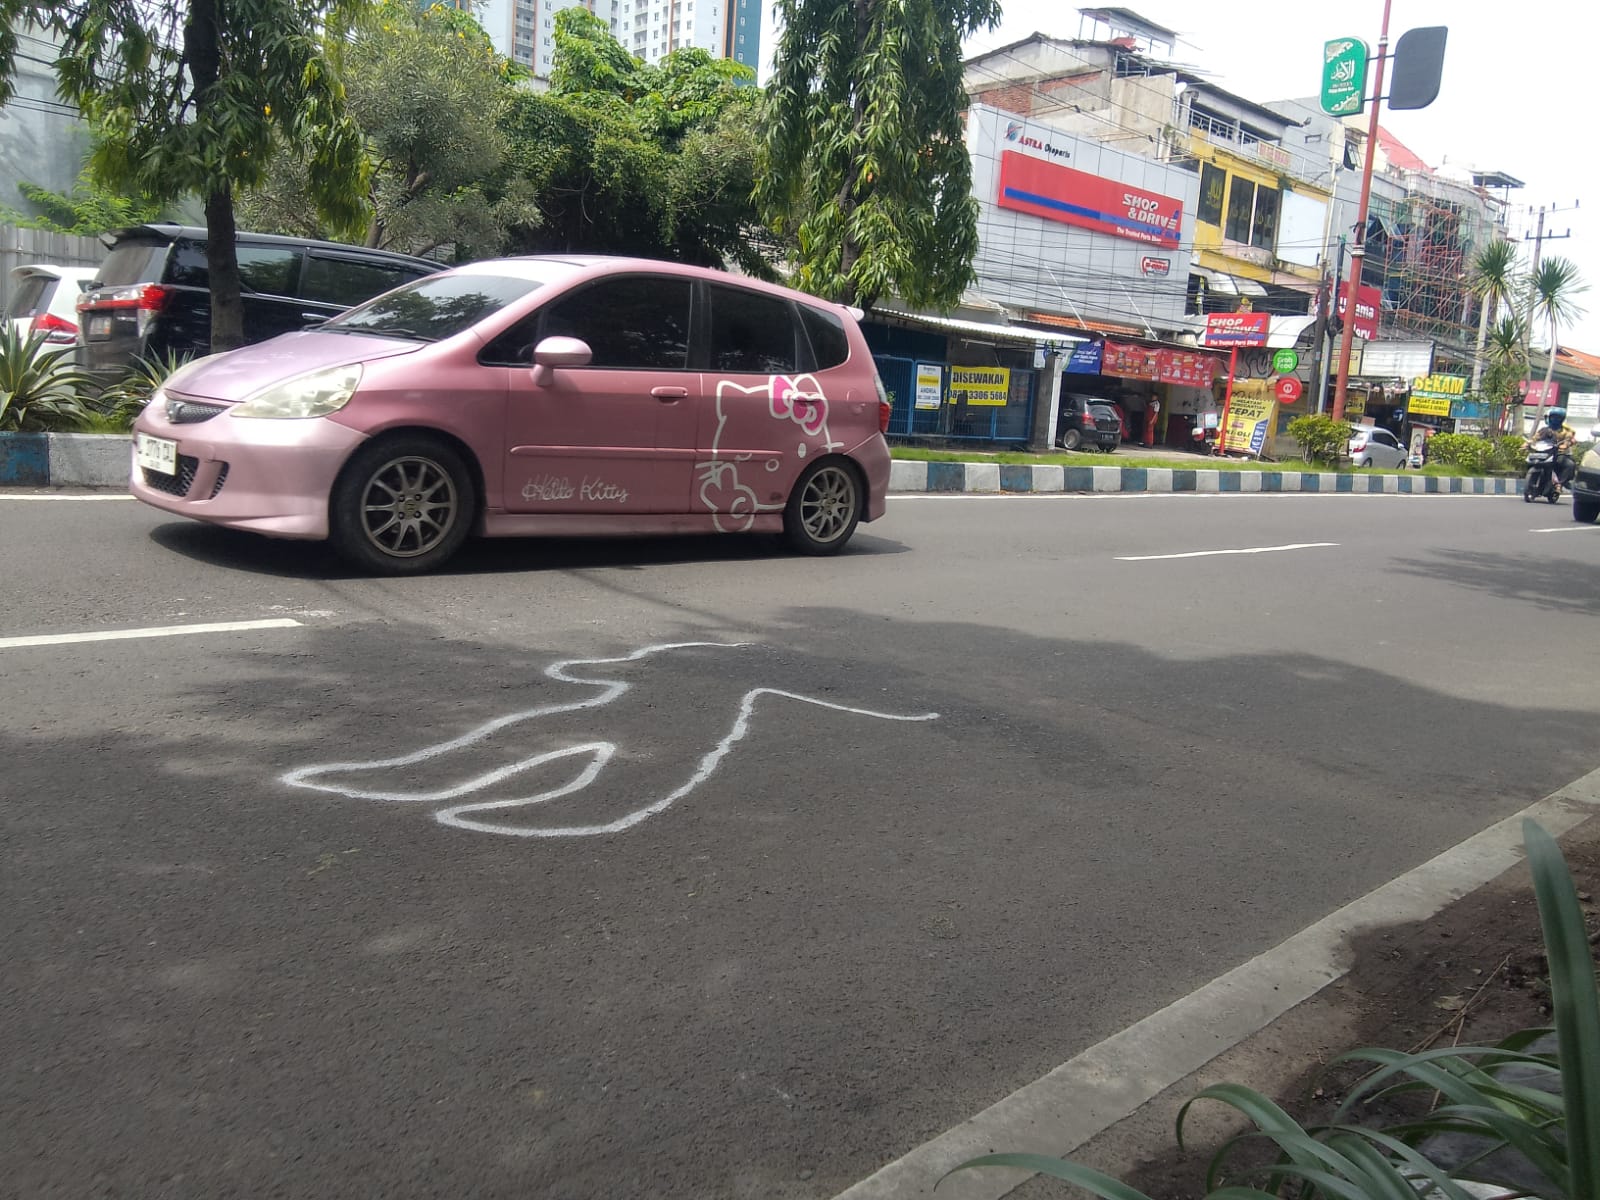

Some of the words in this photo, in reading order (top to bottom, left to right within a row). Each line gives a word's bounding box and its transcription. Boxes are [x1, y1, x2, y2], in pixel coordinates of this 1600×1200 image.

[1018, 135, 1042, 150] ASTRA
[1122, 193, 1159, 212] SHOP
[1209, 318, 1244, 327] SHOP
[953, 371, 1005, 386] DISEWAKAN
[1229, 407, 1263, 419] CEPAT
[521, 474, 575, 502] Hello
[580, 474, 629, 503] Kitty
